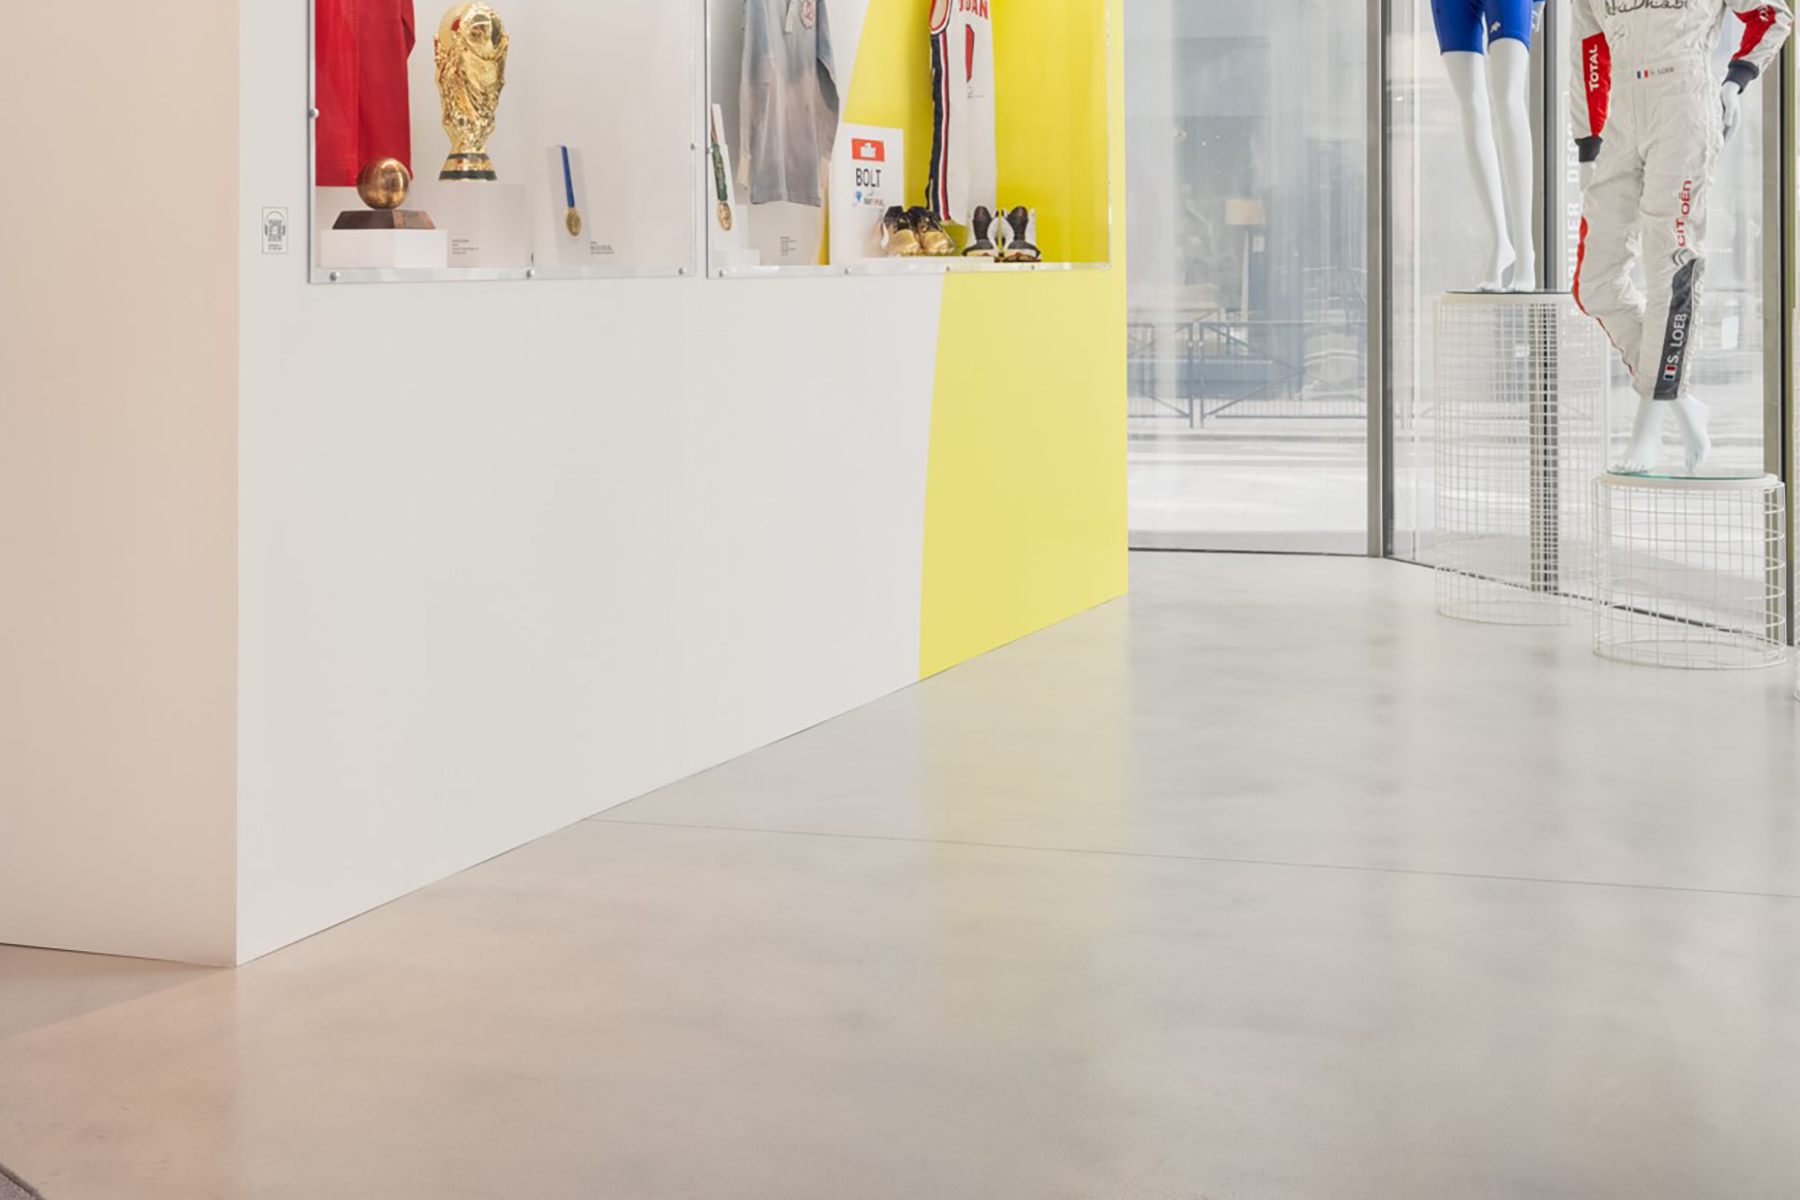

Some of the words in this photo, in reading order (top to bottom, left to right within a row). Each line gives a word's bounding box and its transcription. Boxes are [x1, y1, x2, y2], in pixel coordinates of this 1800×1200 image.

[1588, 44, 1599, 91] TOTAL
[856, 168, 881, 188] BOLT
[1670, 313, 1687, 348] LOEB
